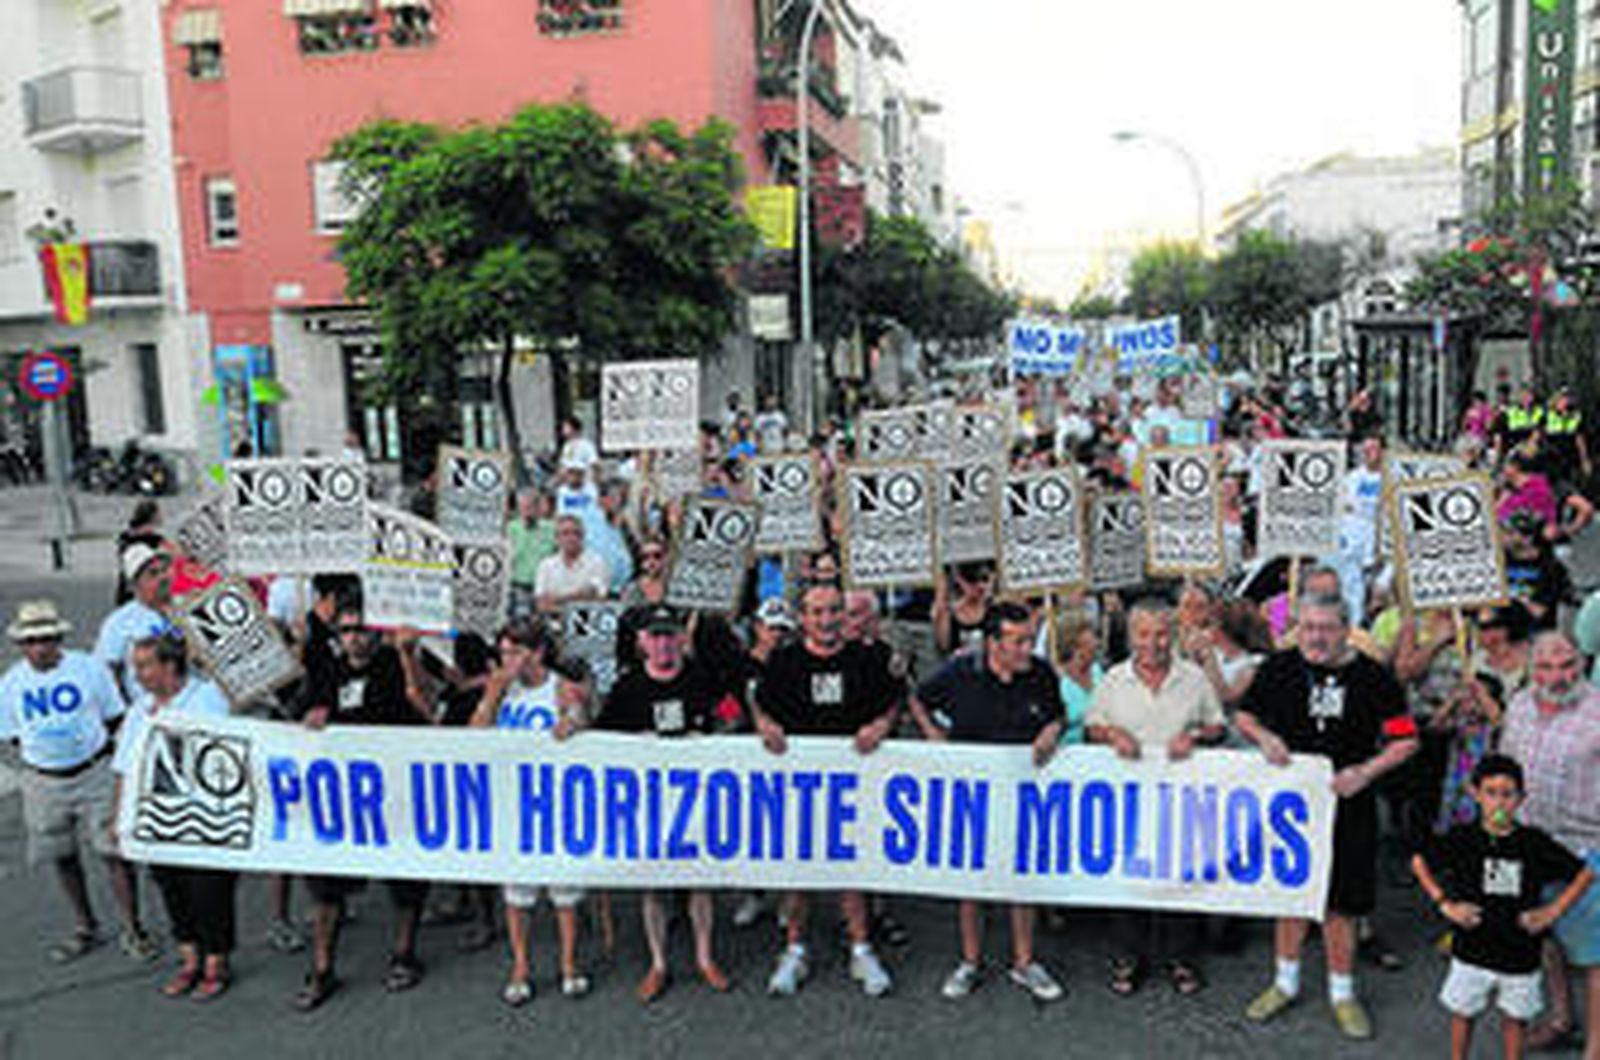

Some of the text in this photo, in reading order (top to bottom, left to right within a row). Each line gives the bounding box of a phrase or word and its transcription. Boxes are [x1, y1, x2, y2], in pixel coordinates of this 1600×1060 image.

[1014, 327, 1051, 353] NO
[230, 467, 360, 506] NO NO
[451, 457, 501, 490] NO
[755, 462, 807, 494] NO
[1152, 457, 1208, 495] NO
[1277, 452, 1333, 488] NO
[853, 473, 922, 511] NO
[1007, 477, 1071, 516] NO
[1409, 488, 1481, 532] NO
[692, 507, 749, 543] NO
[190, 591, 249, 641] NO
[23, 683, 82, 720] NO
[498, 702, 555, 728] NO
[150, 729, 246, 798] NO
[267, 756, 1311, 888] POR UN HORIZONTE SIN MOLINOS
